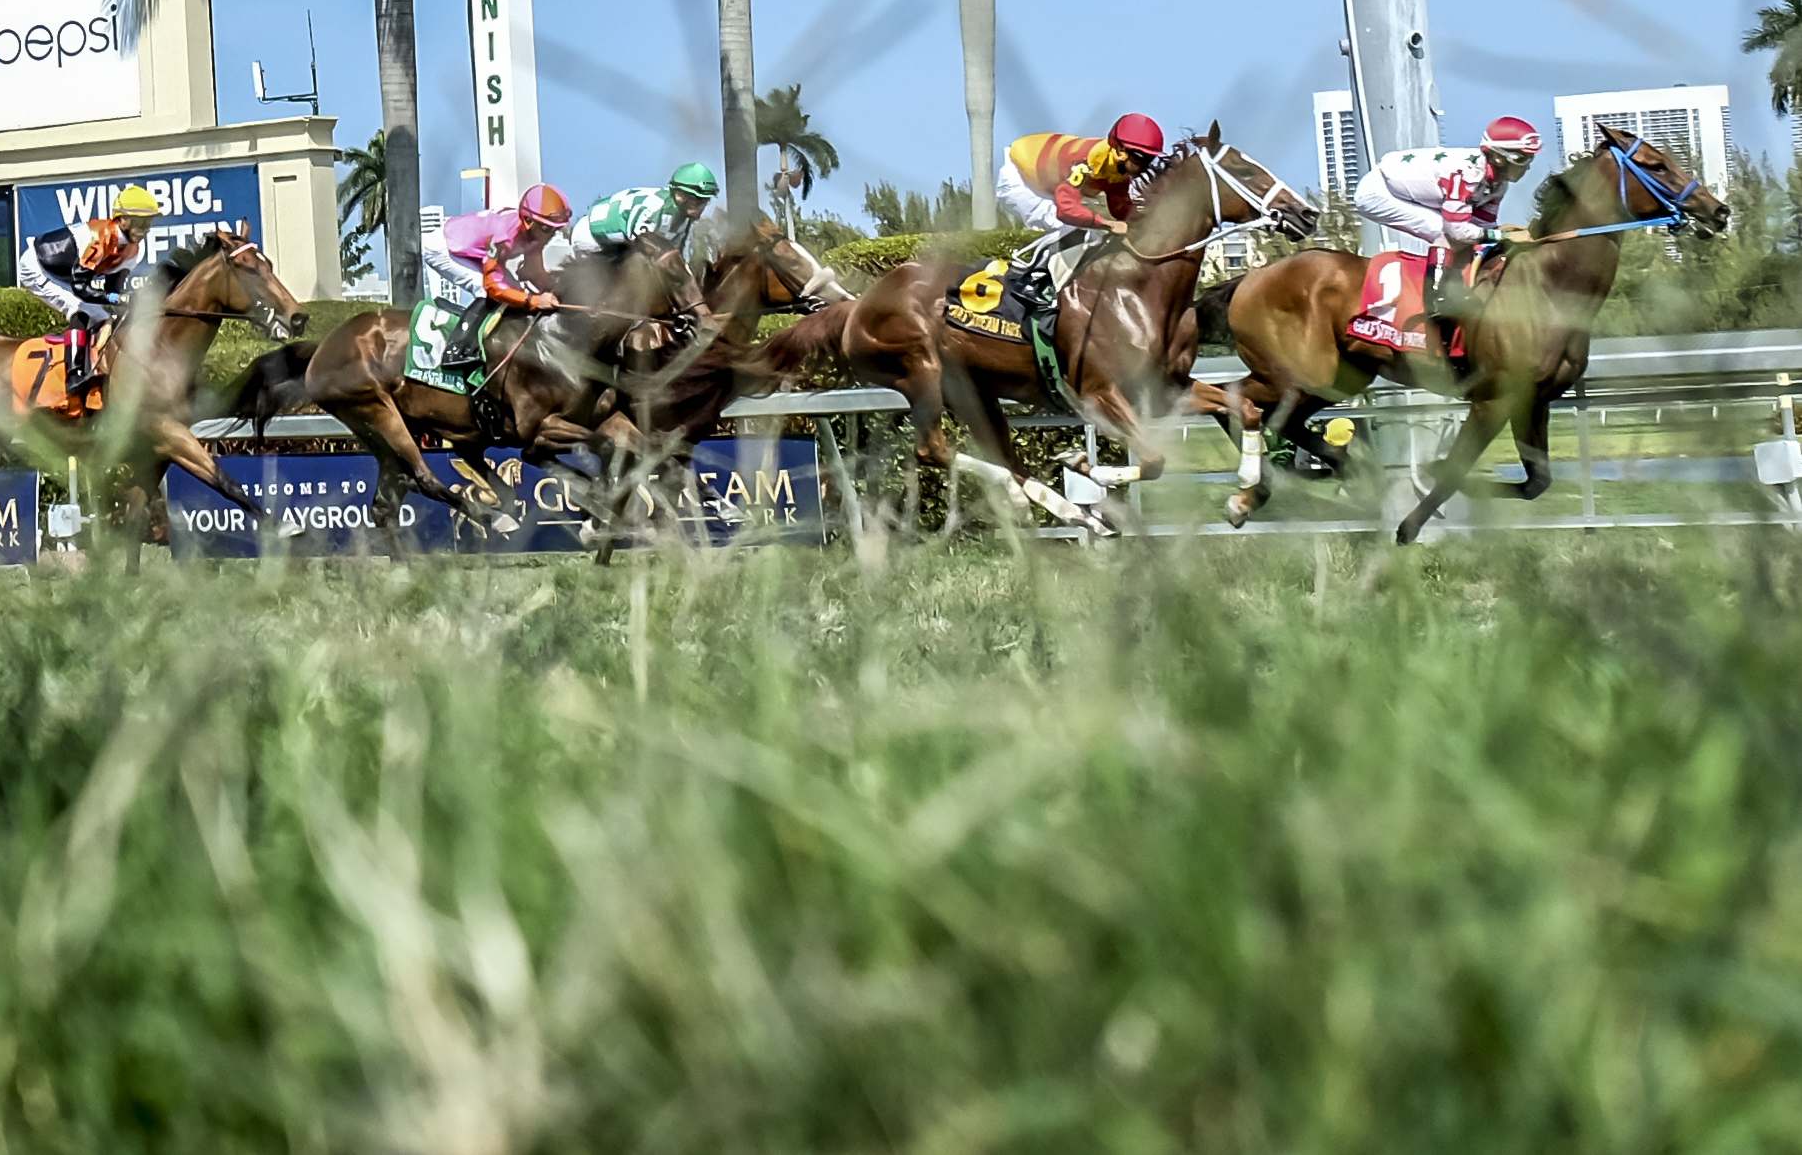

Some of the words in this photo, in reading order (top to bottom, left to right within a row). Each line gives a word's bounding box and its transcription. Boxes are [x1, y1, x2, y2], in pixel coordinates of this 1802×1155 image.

[145, 176, 223, 217] BIG.
[1450, 174, 1463, 200] 1
[84, 246, 98, 265] 7
[137, 219, 244, 265] FTE
[960, 259, 1009, 314] 6
[1367, 261, 1403, 323] 1
[412, 304, 451, 370] 5
[27, 348, 54, 403] 7
[241, 481, 327, 497] ELCOME
[341, 480, 367, 494] TO
[533, 469, 796, 518] GUSEAM
[182, 508, 246, 533] YOUR
[252, 503, 416, 533] AYGROUD
